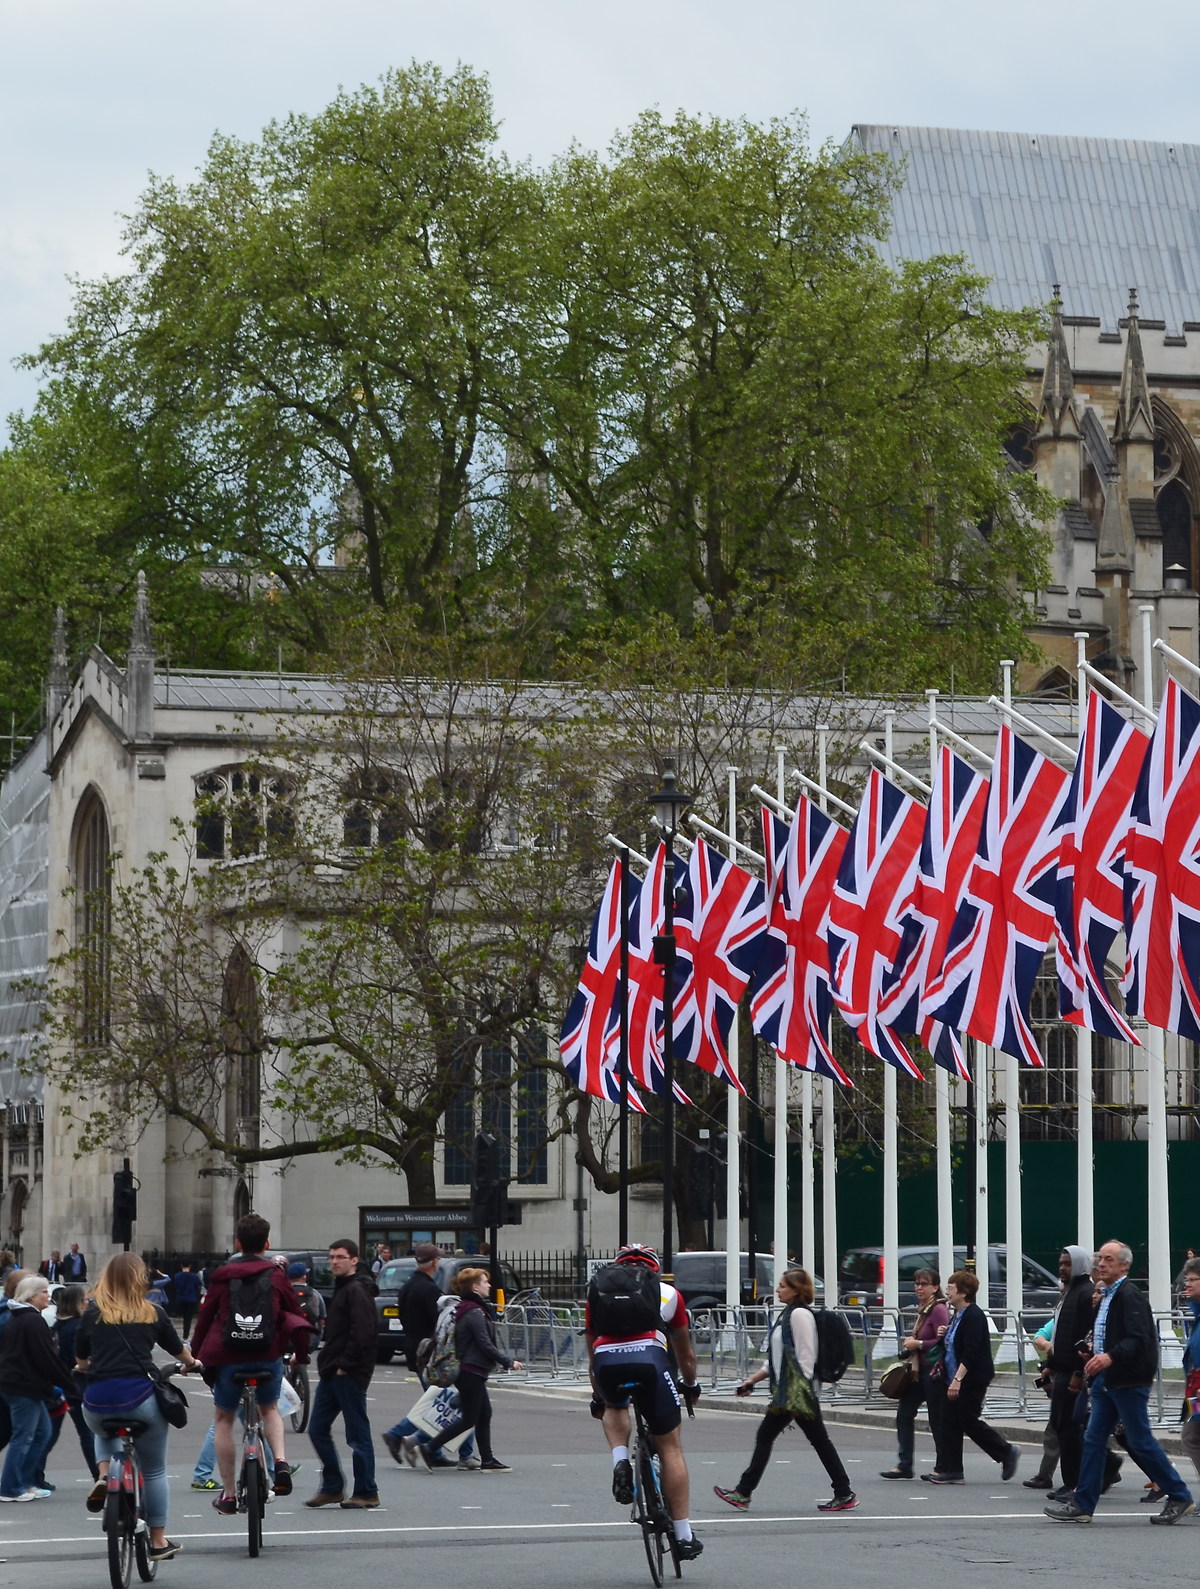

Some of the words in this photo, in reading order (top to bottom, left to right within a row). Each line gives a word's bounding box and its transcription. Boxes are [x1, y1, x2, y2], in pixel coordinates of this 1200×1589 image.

[404, 1214, 446, 1222] Westminster
[447, 1213, 468, 1223] Abbey
[231, 1331, 264, 1340] adidas
[432, 1398, 453, 1417] YOU
